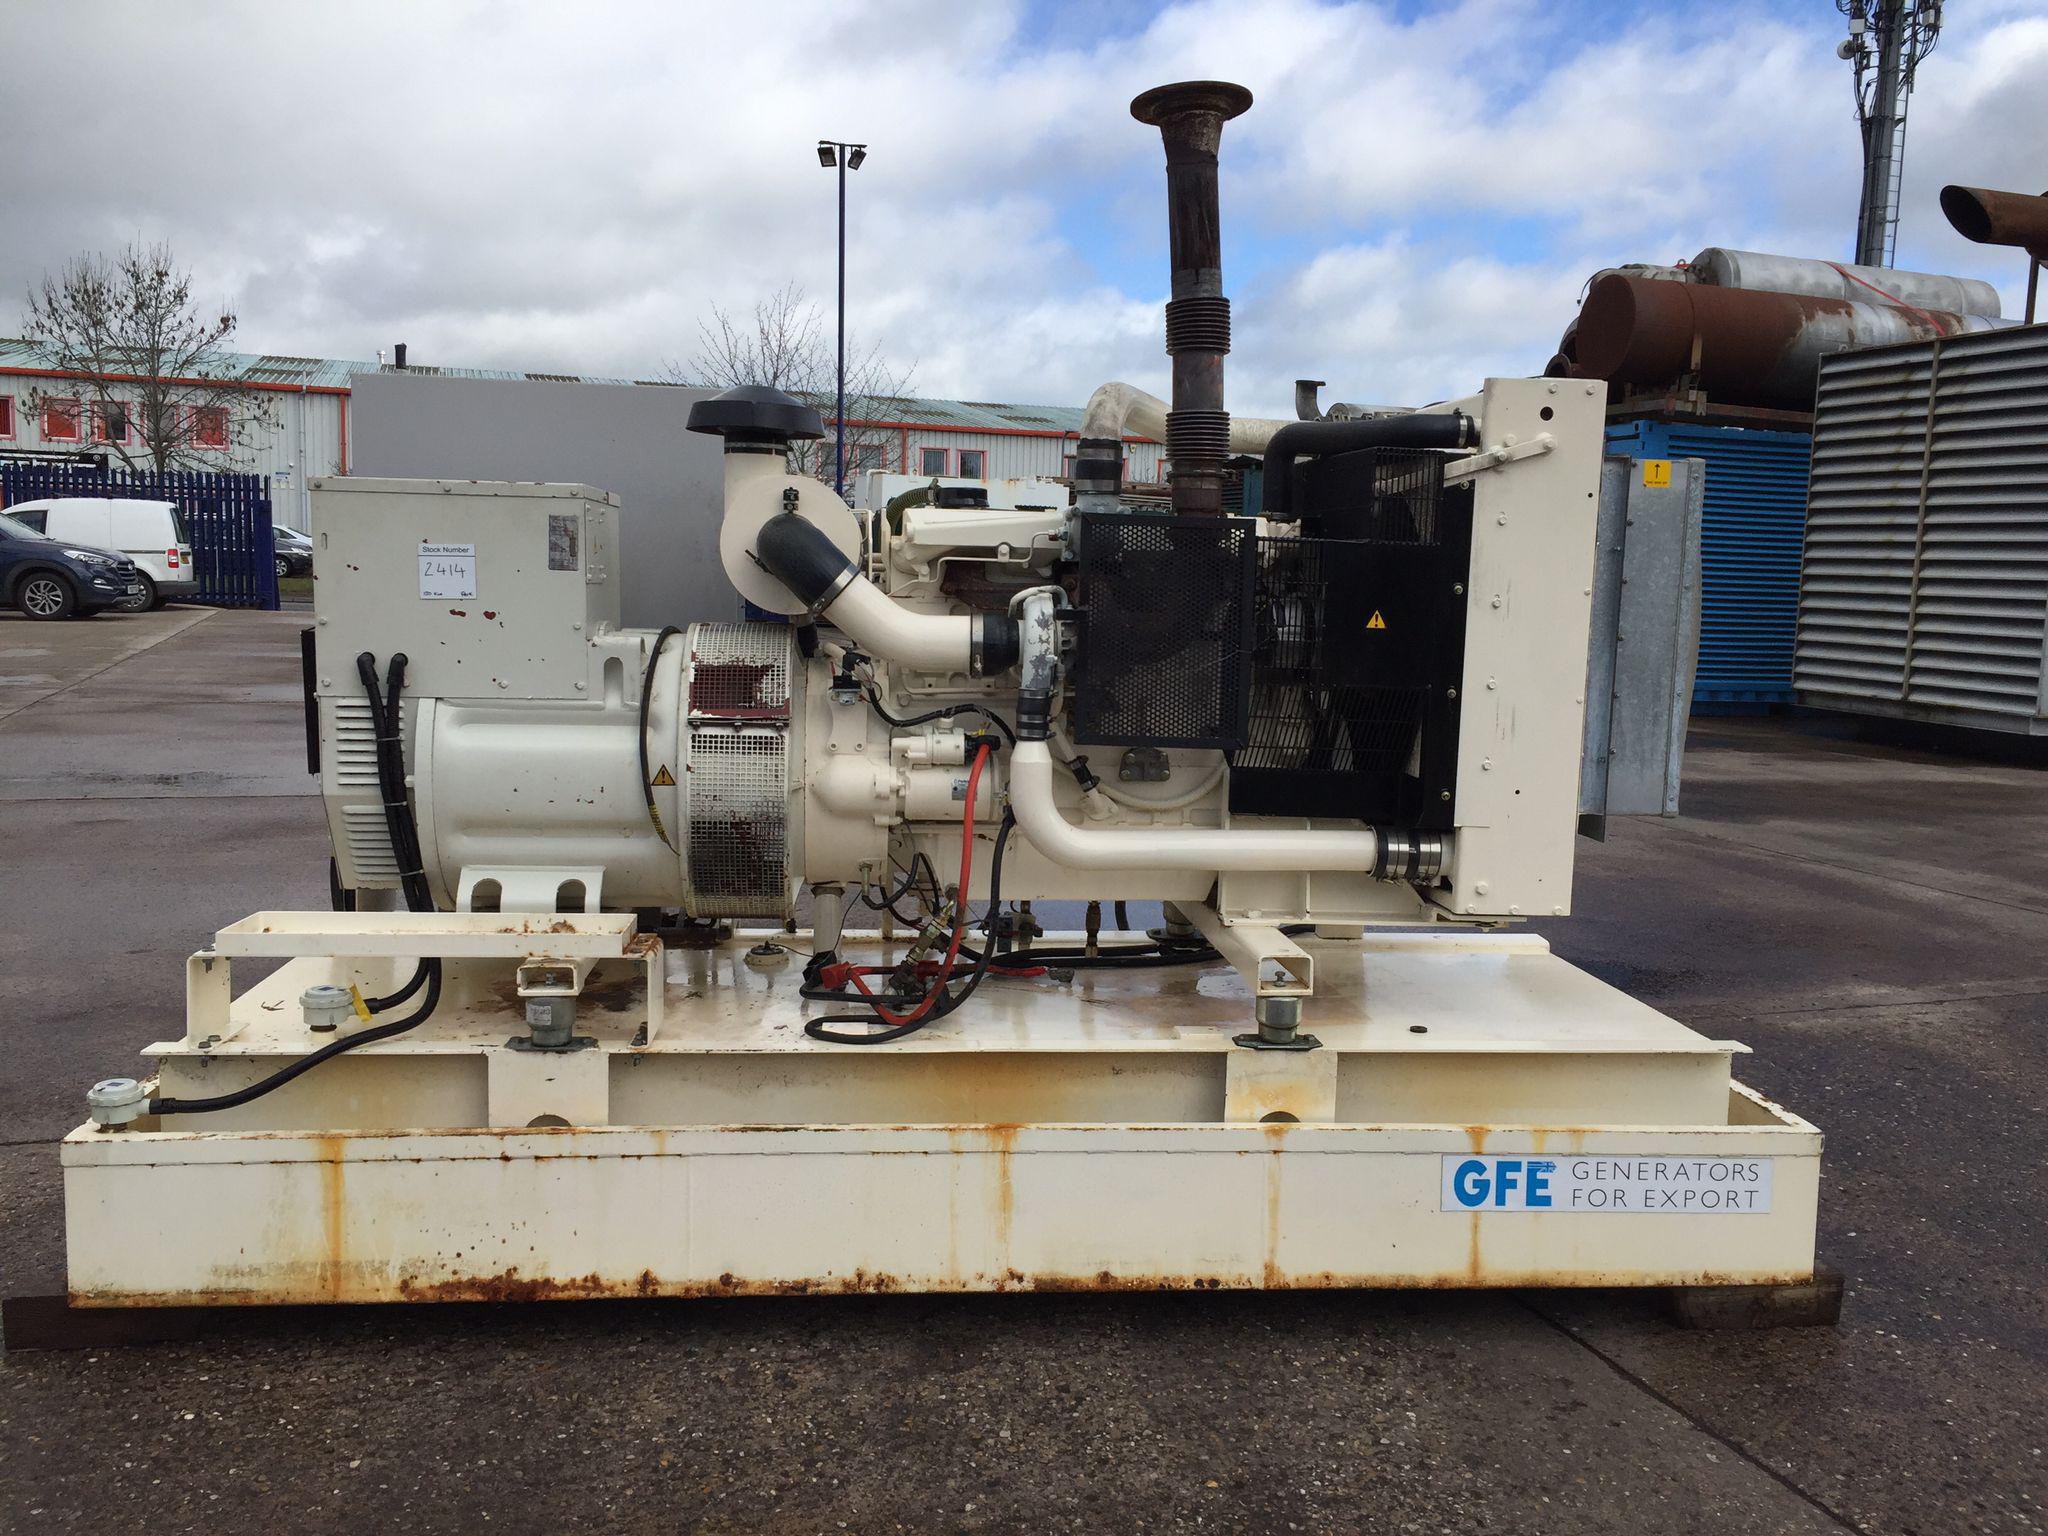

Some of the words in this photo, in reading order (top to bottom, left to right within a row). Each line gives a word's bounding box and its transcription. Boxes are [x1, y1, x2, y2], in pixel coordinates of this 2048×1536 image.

[424, 561, 466, 579] 2414
[1572, 1161, 1759, 1182] GENERATORS
[1453, 1159, 1556, 1207] GFE
[1572, 1189, 1627, 1208] FOR
[1644, 1190, 1759, 1209] EXPORT
